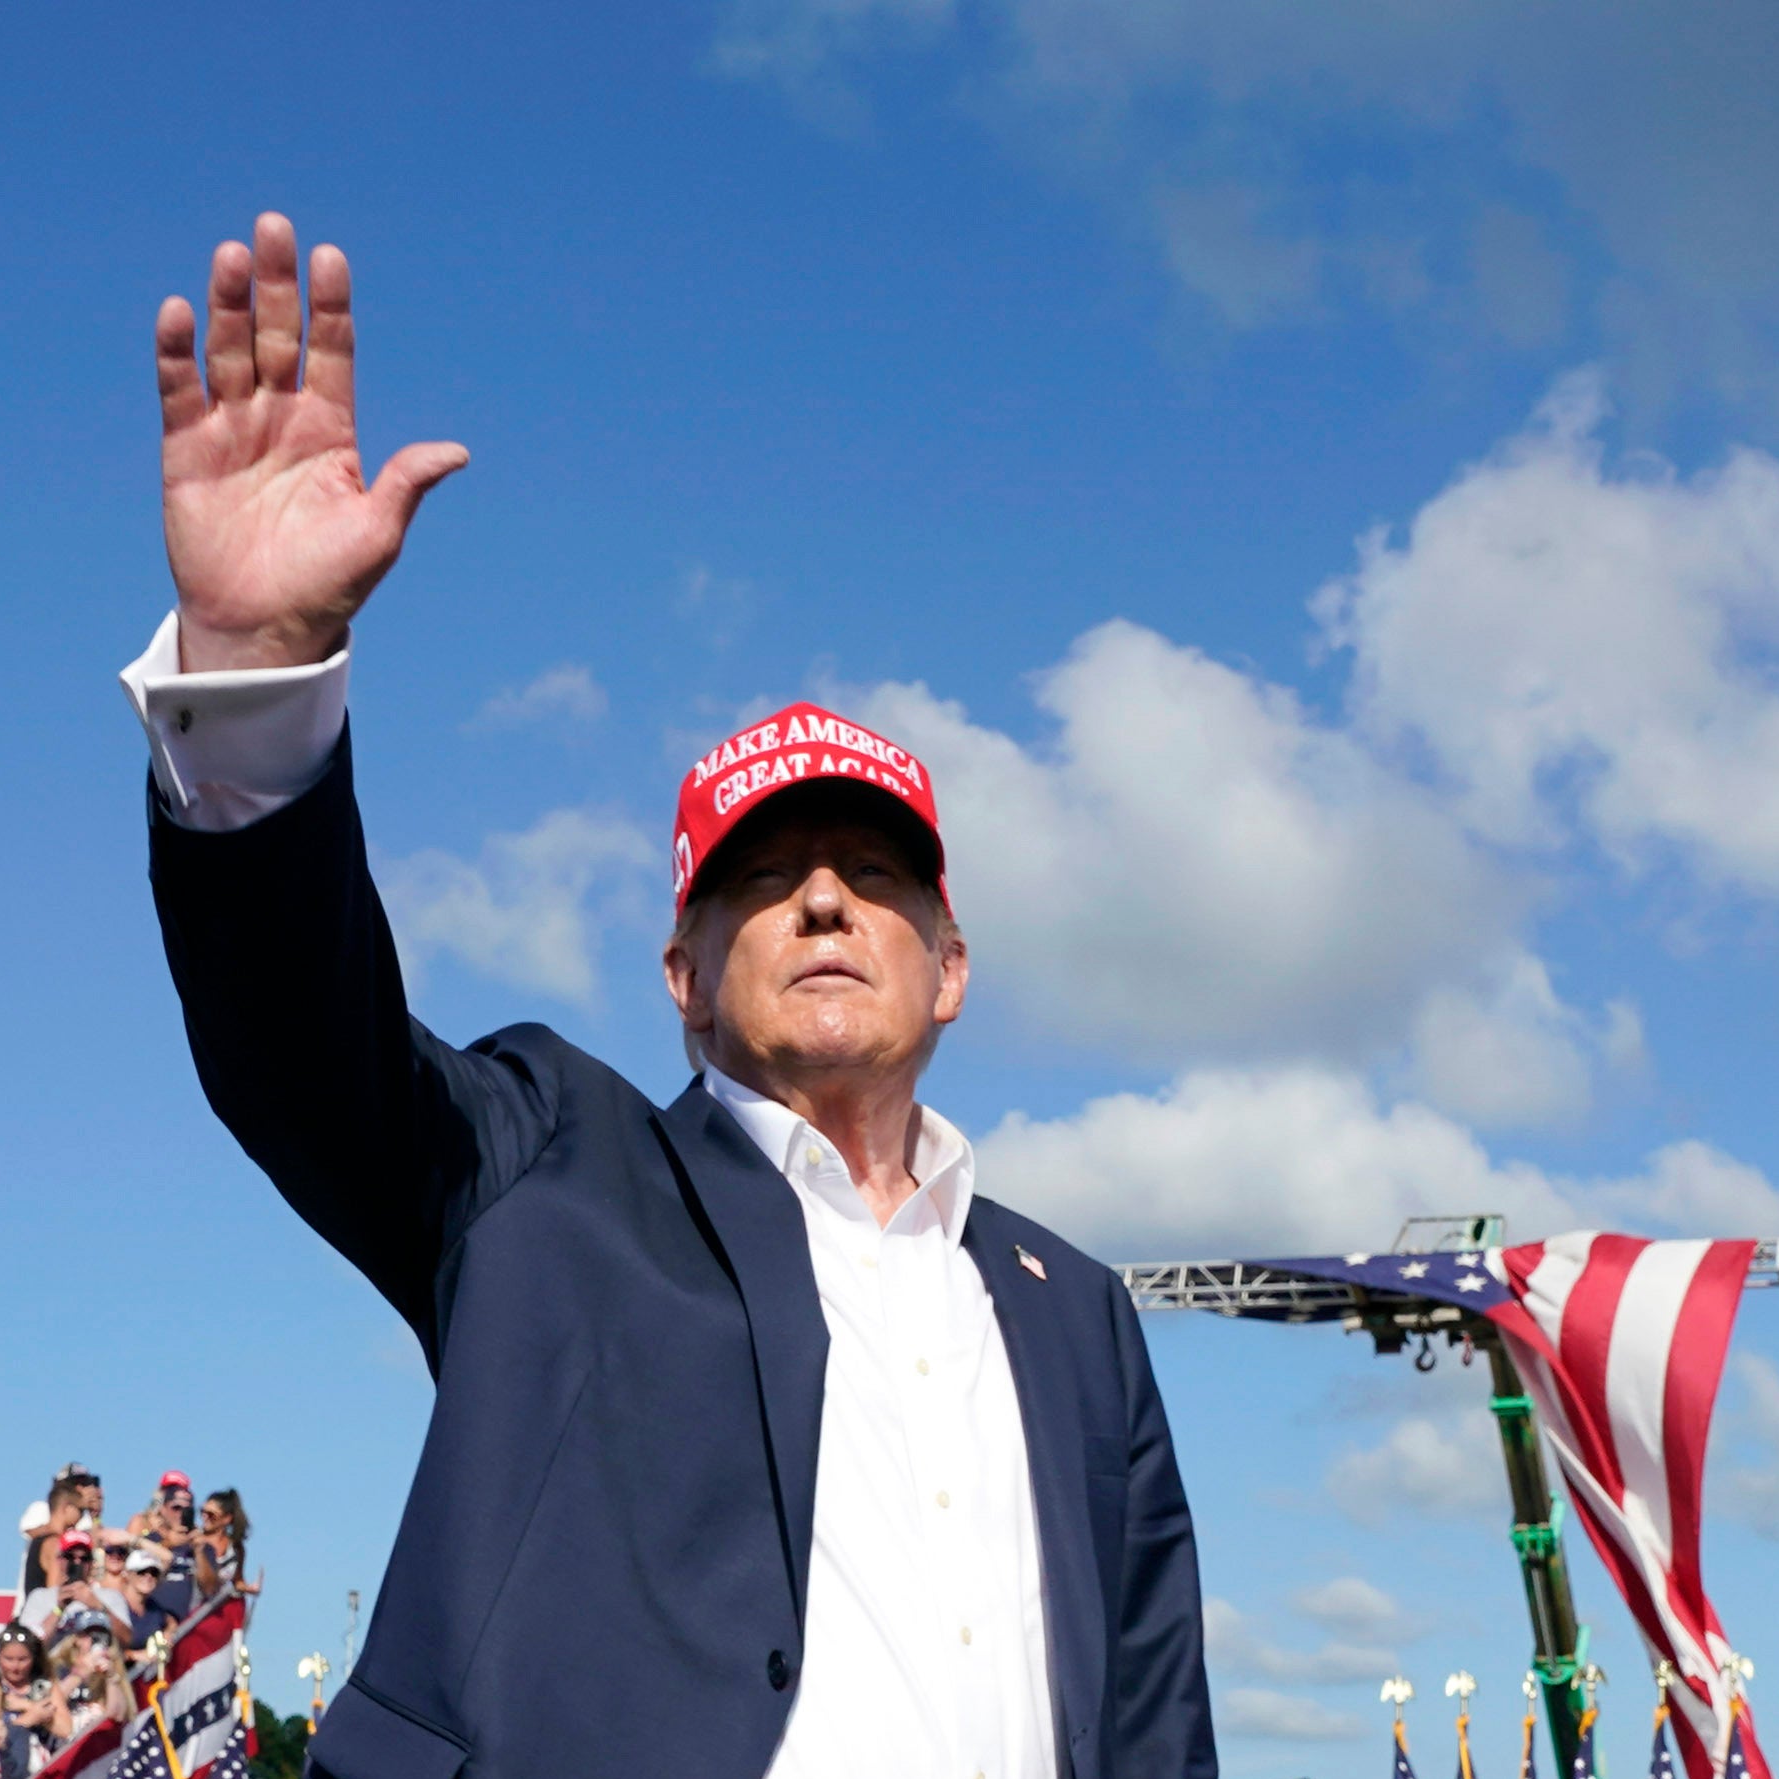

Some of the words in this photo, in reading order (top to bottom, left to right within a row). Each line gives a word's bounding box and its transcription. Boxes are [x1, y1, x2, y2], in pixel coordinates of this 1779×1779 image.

[693, 722, 782, 788] MAKE
[783, 715, 924, 791] AMERICA
[714, 753, 812, 815] GREAT
